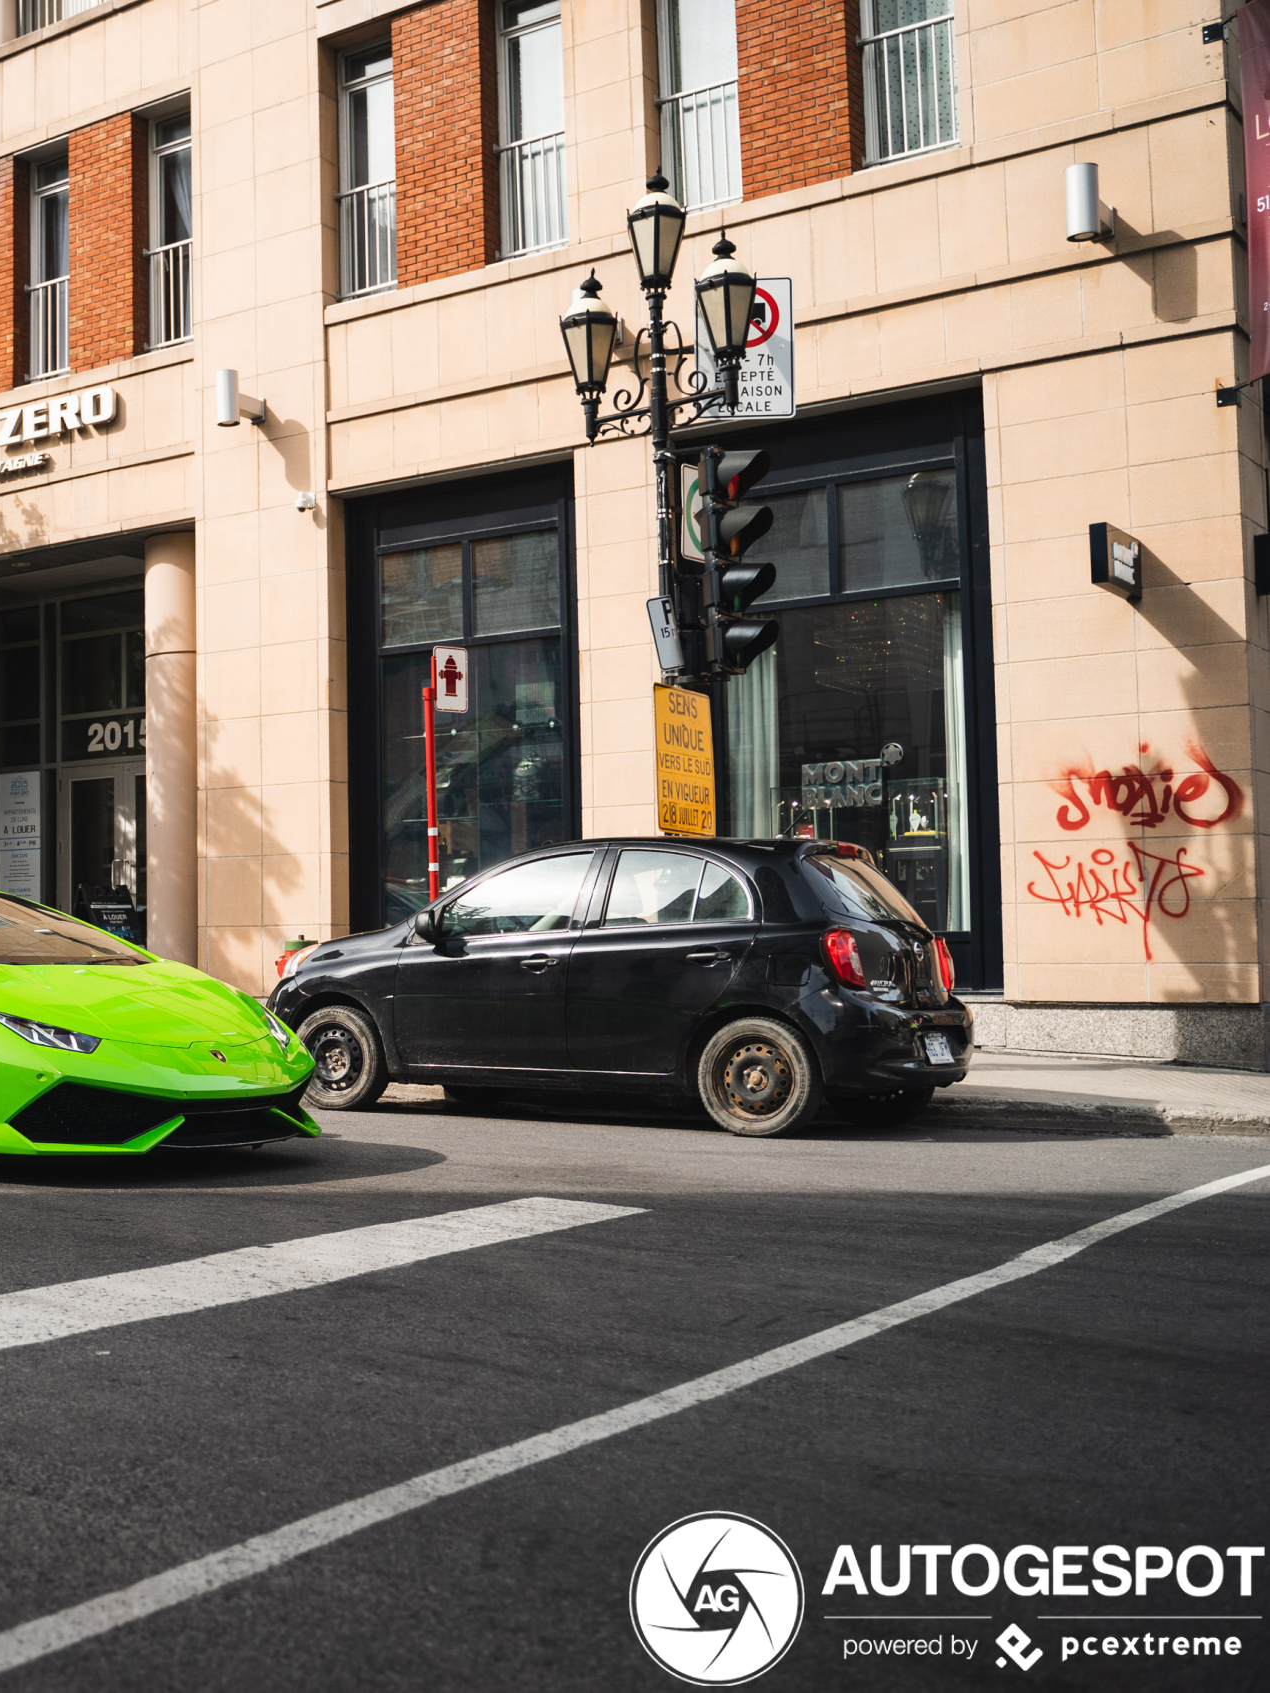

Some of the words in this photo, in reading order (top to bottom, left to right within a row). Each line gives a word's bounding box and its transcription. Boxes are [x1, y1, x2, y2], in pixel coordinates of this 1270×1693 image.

[1255, 114, 1270, 141] L
[1263, 301, 1270, 312] 2
[757, 353, 774, 366] 7h
[715, 367, 774, 383] EEPTÉ
[661, 599, 672, 626] P
[660, 626, 671, 639] 15
[668, 691, 698, 719] SENS
[663, 722, 705, 752] UNIQUE
[658, 752, 681, 771] VERS
[682, 756, 693, 773] LE
[694, 759, 711, 776] SUD
[802, 759, 882, 785] MONT
[11, 780, 29, 789] 2015
[662, 779, 673, 799] EN
[674, 781, 710, 806] VIGUEUR
[802, 783, 882, 809] BLANC
[662, 803, 677, 825] 28
[678, 806, 699, 827] JUILLET
[12, 824, 36, 835] LOUER
